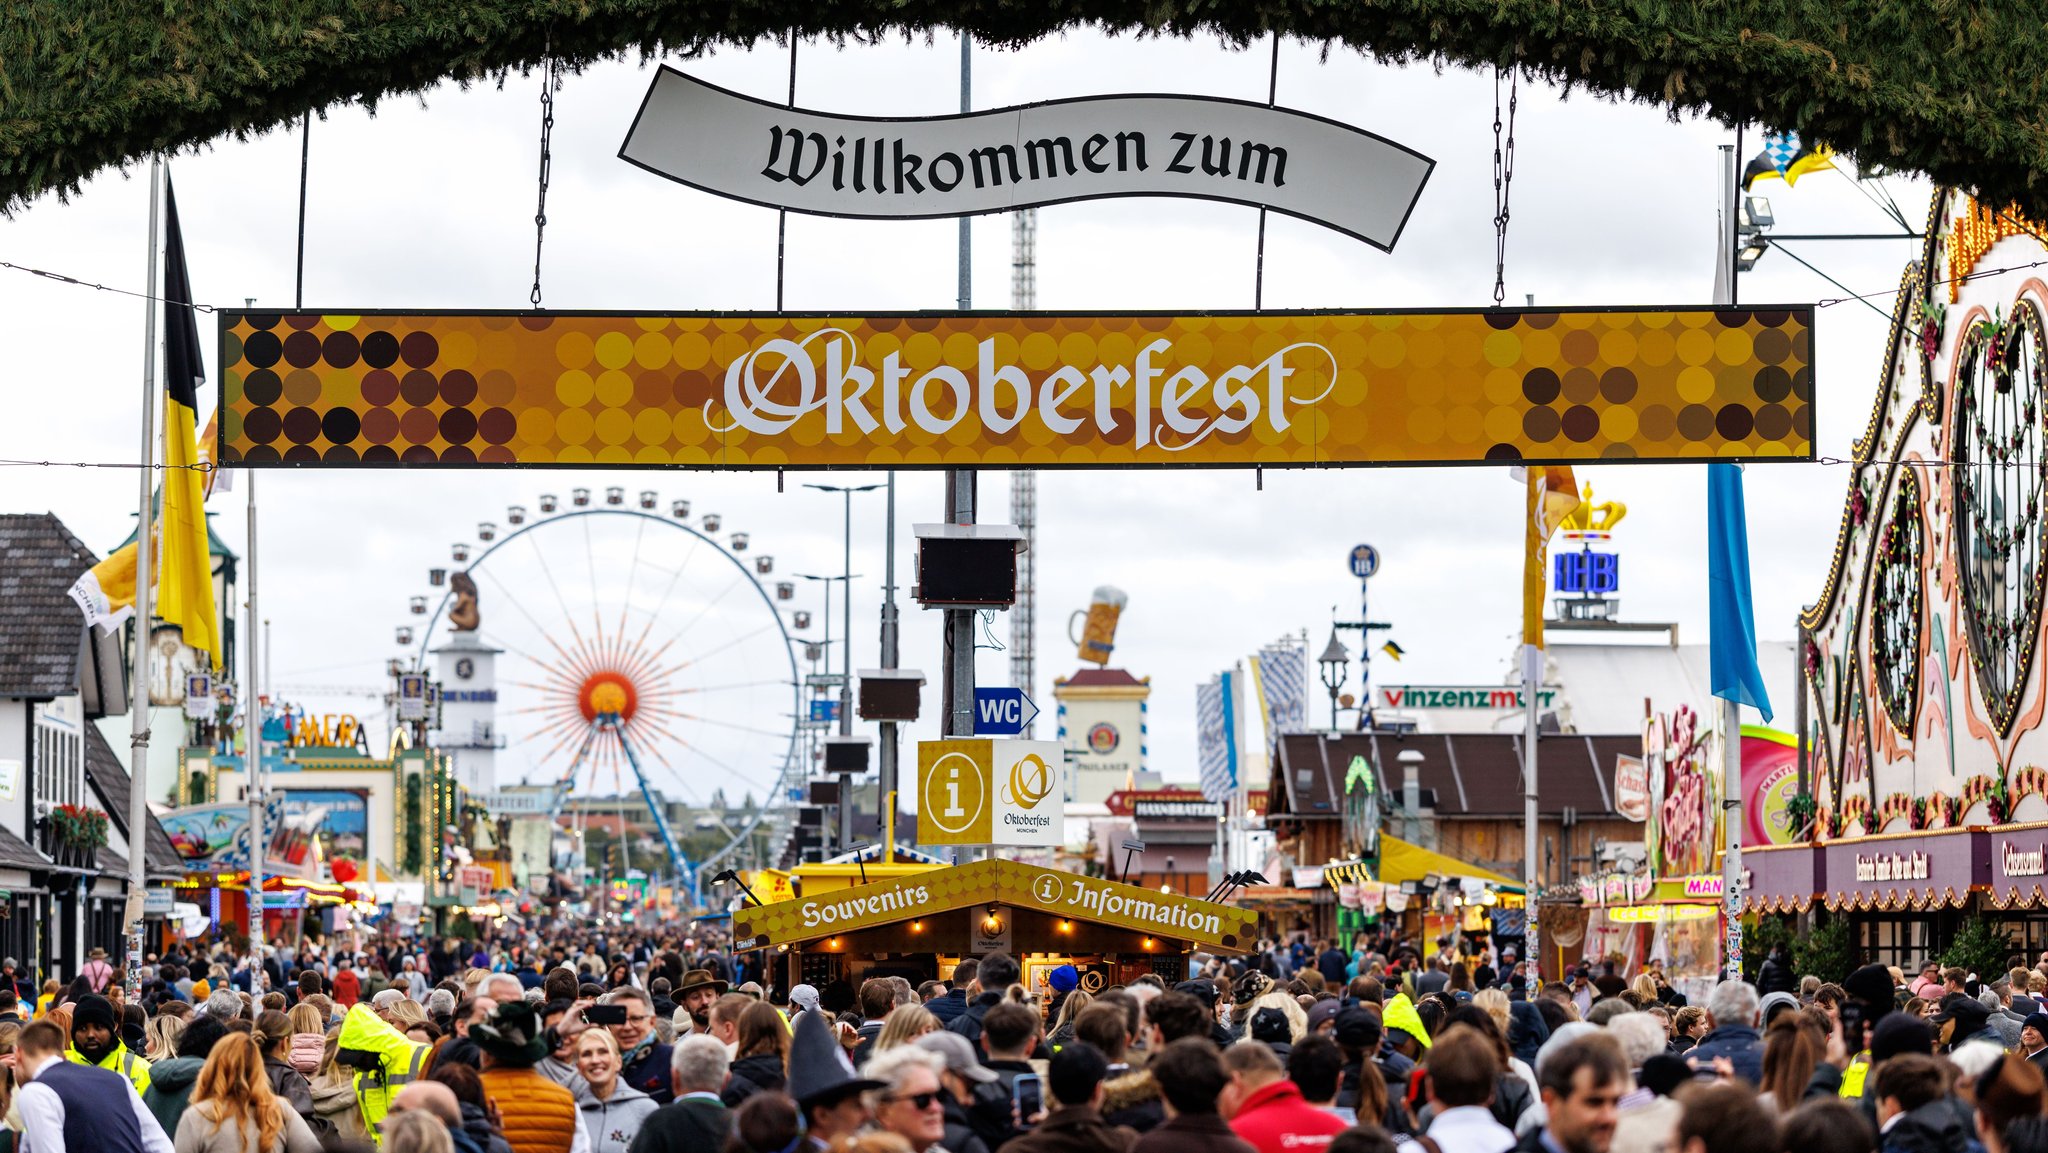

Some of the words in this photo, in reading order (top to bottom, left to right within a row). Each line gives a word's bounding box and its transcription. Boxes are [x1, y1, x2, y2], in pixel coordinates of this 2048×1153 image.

[761, 123, 1149, 196] Willkommen
[1165, 129, 1290, 189] zum
[703, 325, 1338, 451] Oktoberfest
[979, 699, 1020, 724] WC
[1004, 812, 1050, 827] Oktoberfest
[801, 883, 929, 928] Souvenirs
[1067, 880, 1220, 935] Information
